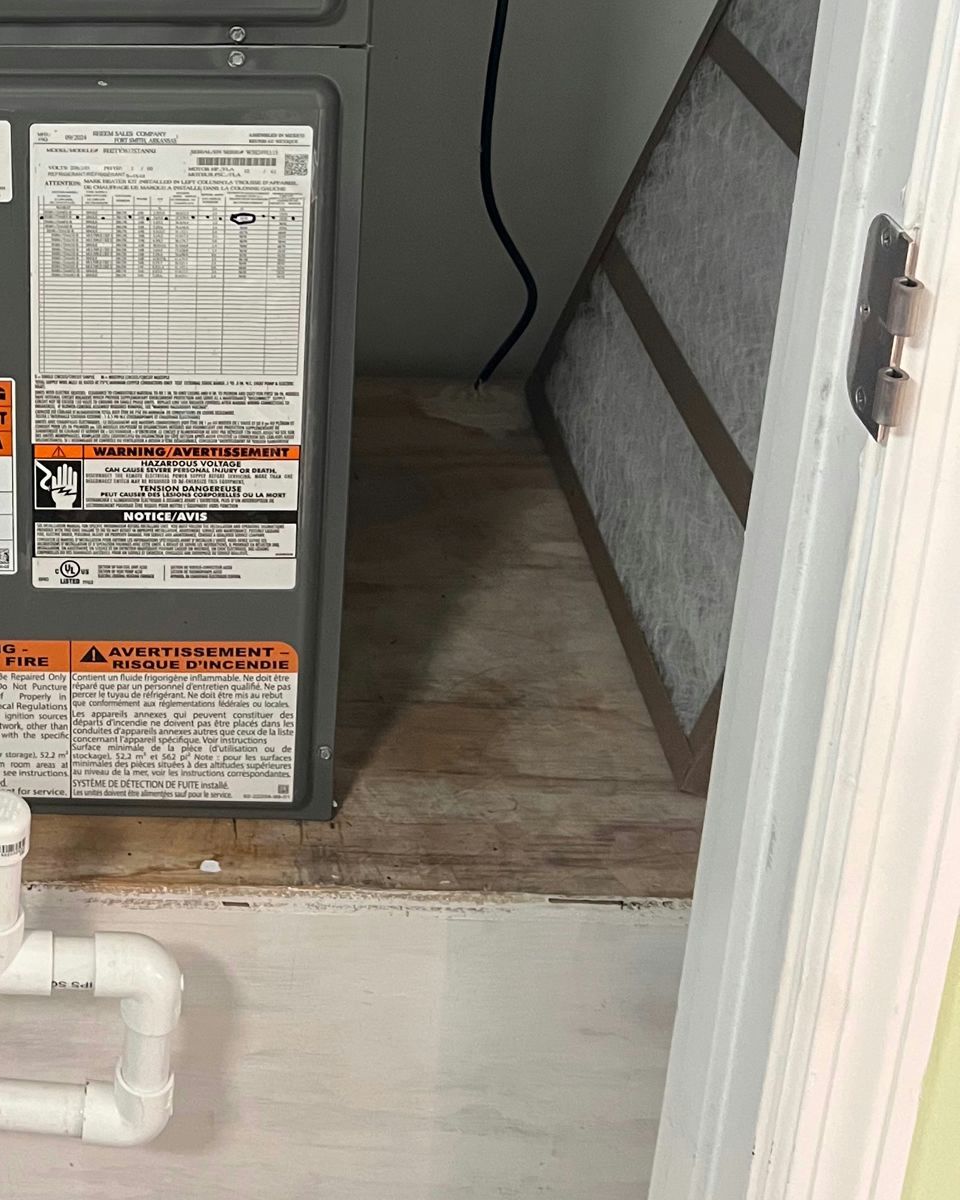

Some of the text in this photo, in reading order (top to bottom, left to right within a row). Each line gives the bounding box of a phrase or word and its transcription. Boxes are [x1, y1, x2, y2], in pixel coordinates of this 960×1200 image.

[93, 447, 290, 458] WARNING/AVERTISSEMENT
[124, 512, 208, 522] NOTICE/AVIS
[109, 647, 274, 657] AVERTISSEMENT
[6, 657, 49, 667] FIRE
[112, 660, 289, 670] RISQUE D'INCENDIE
[11, 673, 45, 682] Repaired
[48, 673, 67, 682] Only
[32, 683, 68, 691] Puncture
[20, 693, 52, 702] Properly
[17, 702, 68, 712] Regulations
